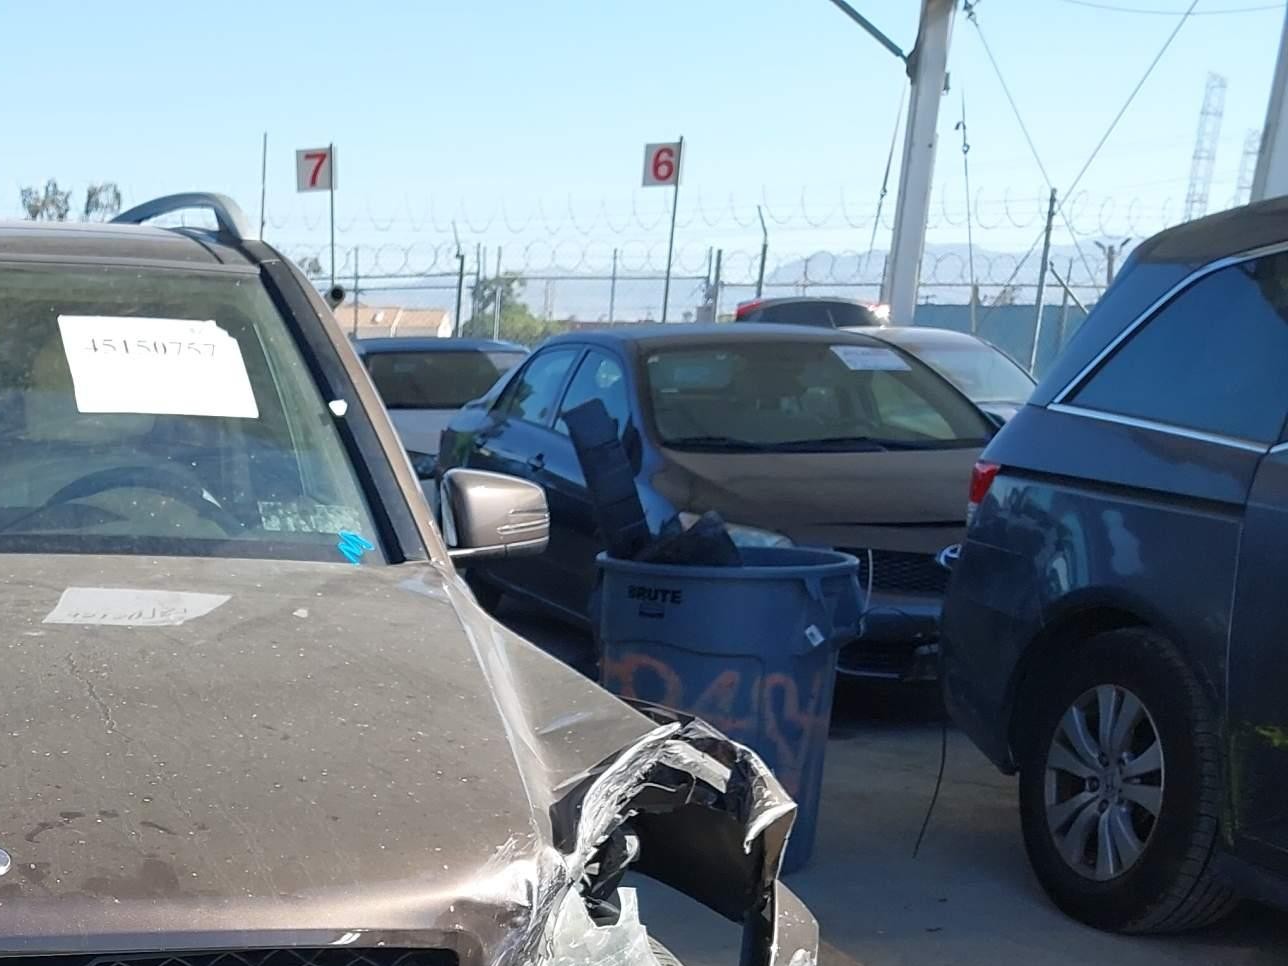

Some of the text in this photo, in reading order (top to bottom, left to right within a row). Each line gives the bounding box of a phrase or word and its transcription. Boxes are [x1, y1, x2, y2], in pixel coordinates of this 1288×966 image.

[305, 153, 326, 187] 7
[653, 148, 673, 181] 6
[628, 585, 682, 604] BRUTE
